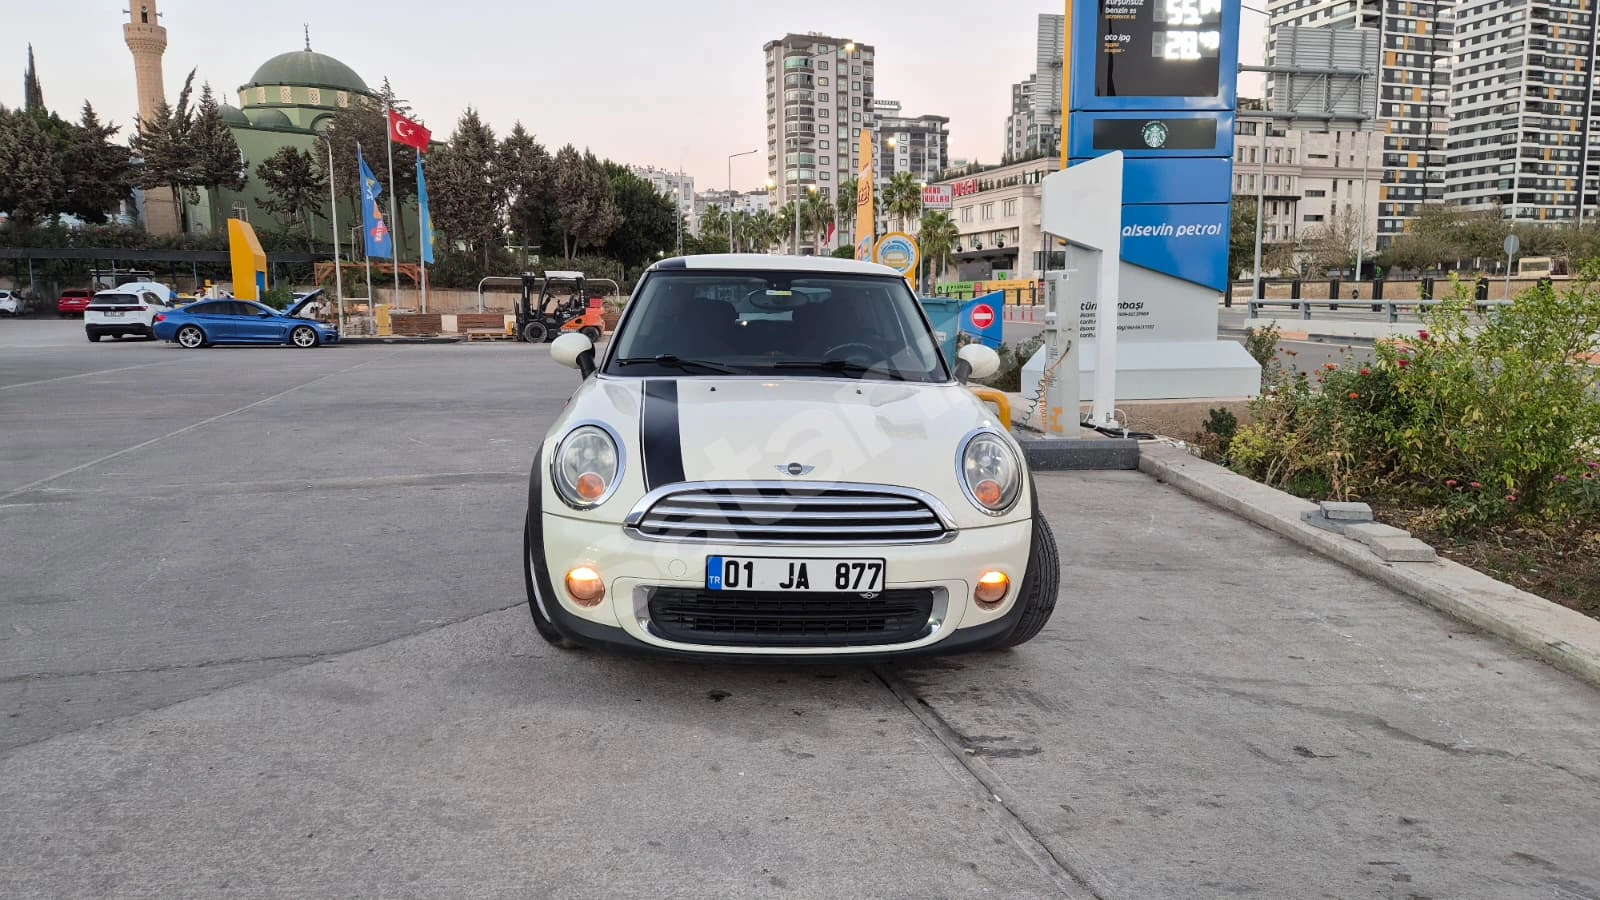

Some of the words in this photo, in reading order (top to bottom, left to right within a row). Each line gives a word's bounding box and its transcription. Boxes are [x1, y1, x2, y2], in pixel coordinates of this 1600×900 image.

[1122, 223, 1173, 237] alsevin
[1176, 223, 1222, 238] petrol
[708, 575, 721, 585] TR
[724, 560, 753, 589] 01
[779, 562, 810, 590] JA
[835, 562, 882, 590] 877
